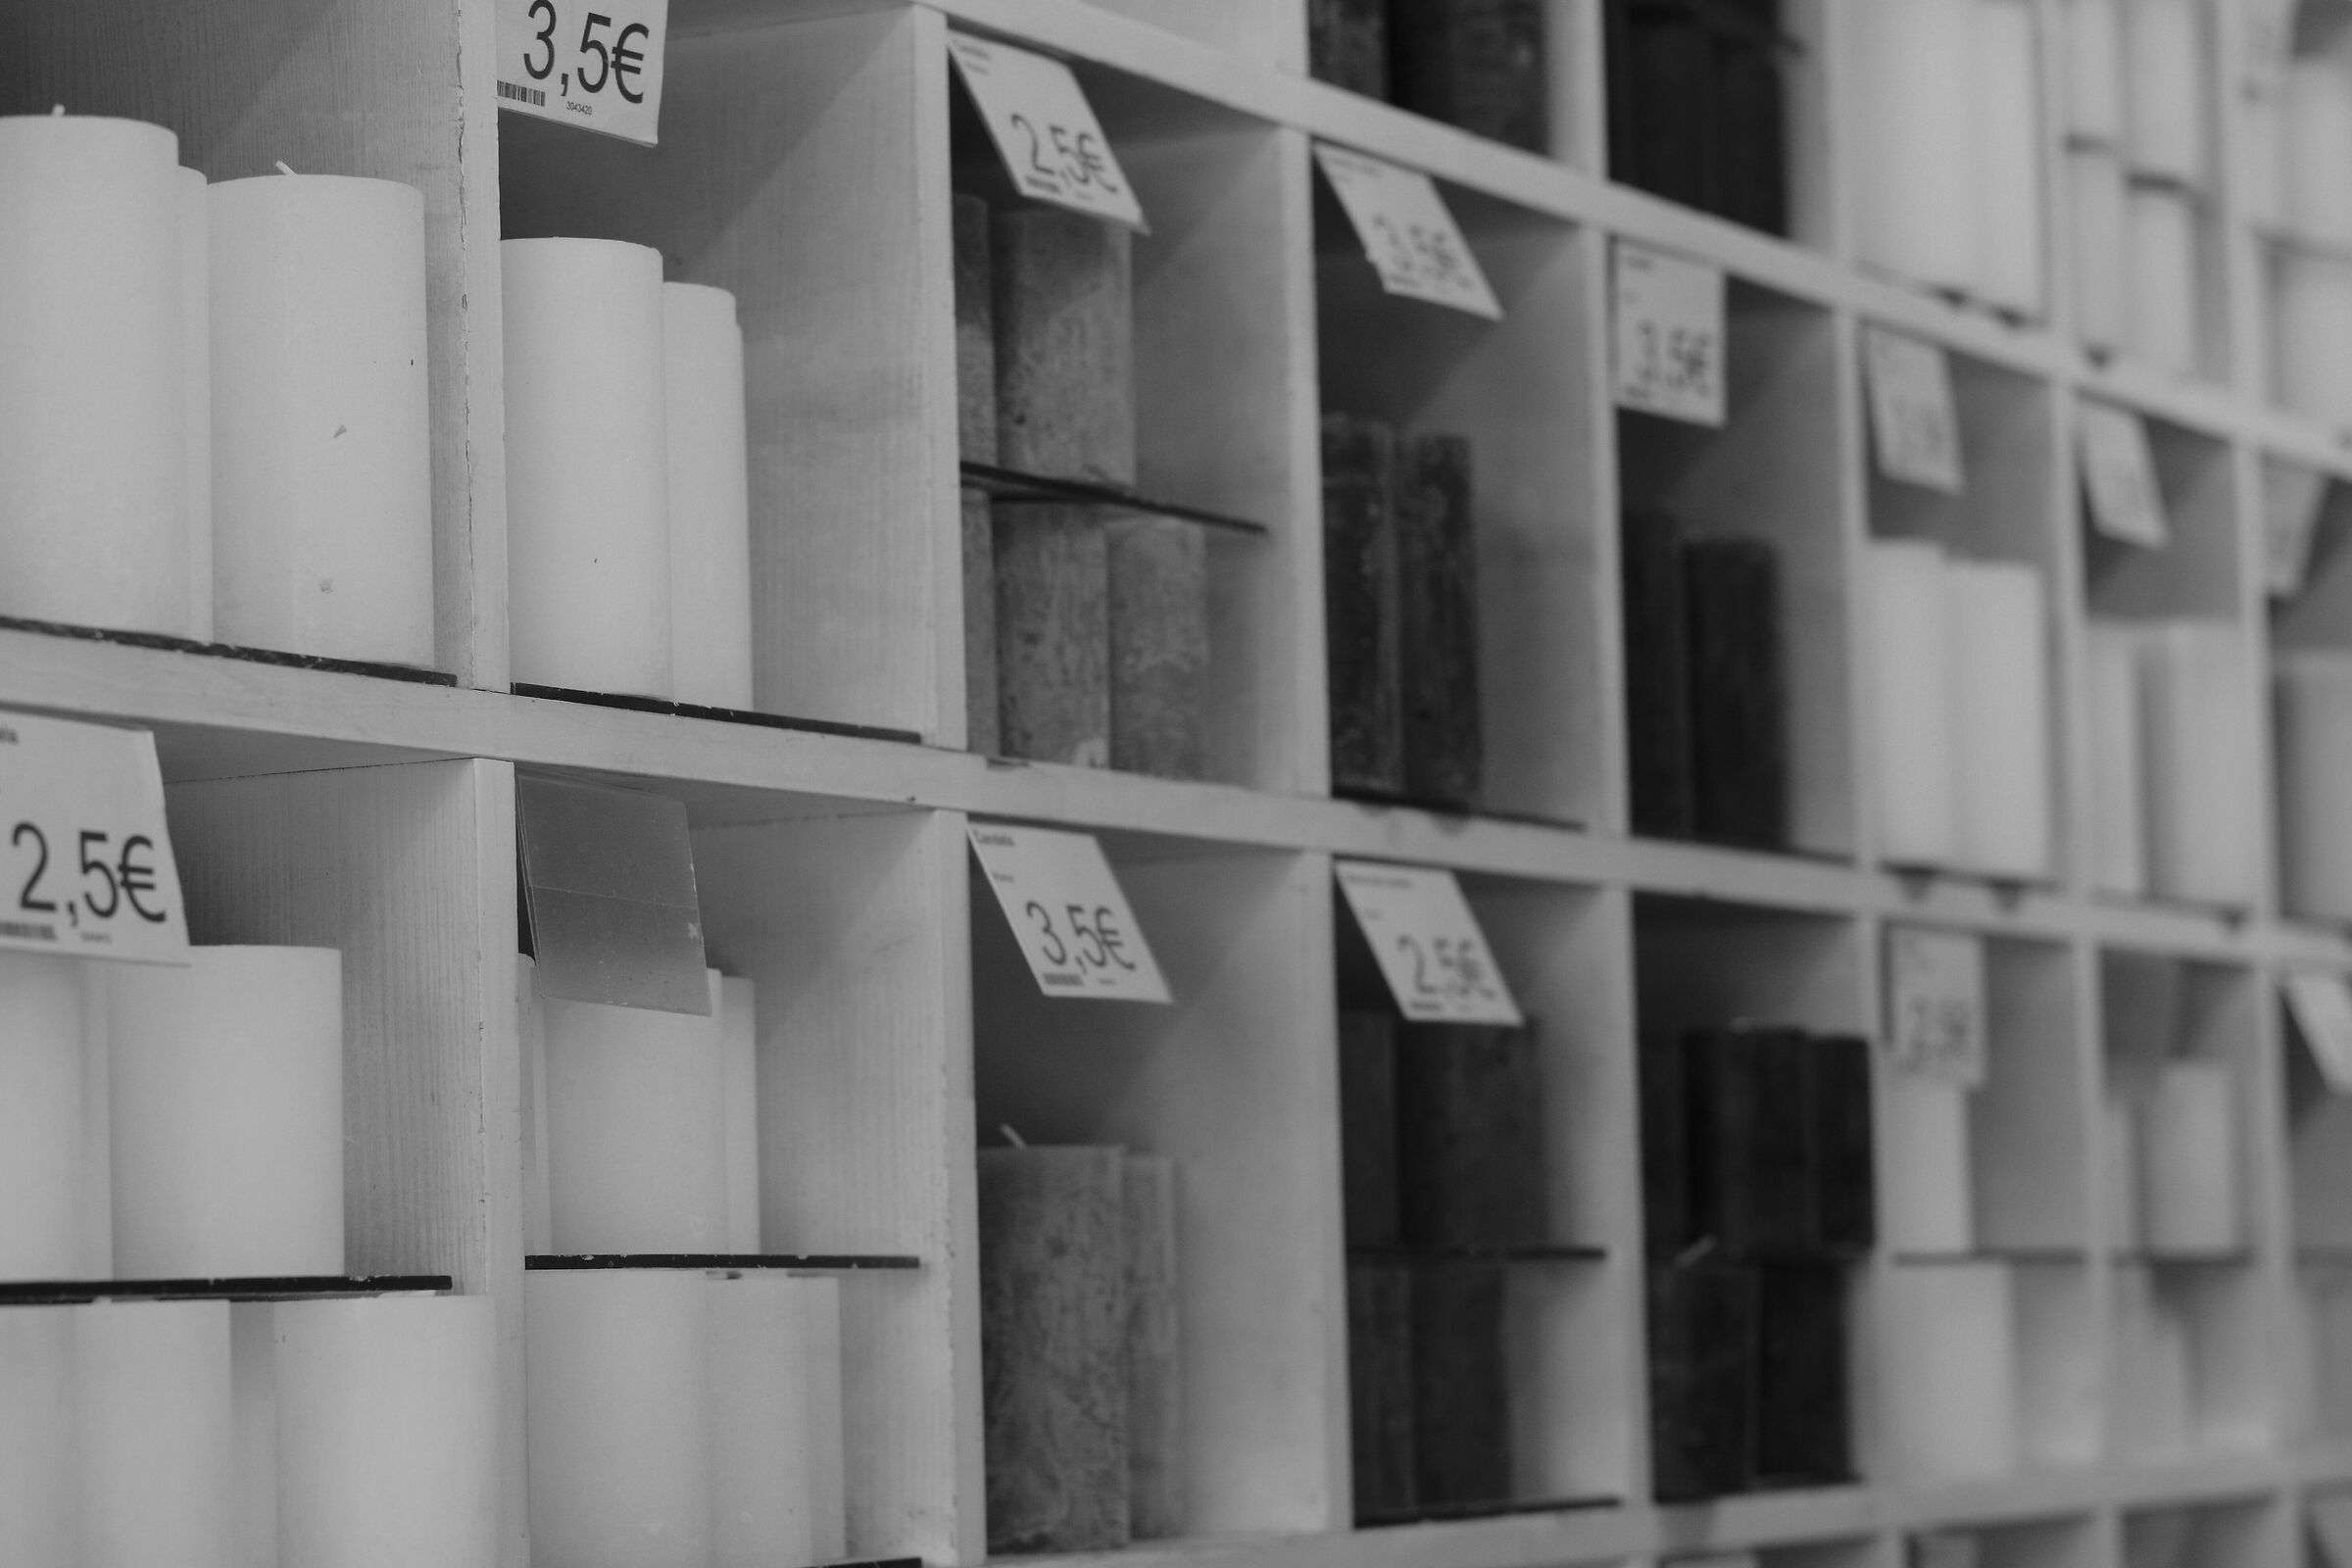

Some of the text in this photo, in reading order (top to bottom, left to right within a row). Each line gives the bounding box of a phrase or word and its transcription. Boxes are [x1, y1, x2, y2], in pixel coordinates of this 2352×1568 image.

[523, 0, 650, 104] 3,5€
[1009, 112, 1120, 195] 2,5€
[12, 820, 167, 929] 2,5€
[1024, 900, 1137, 975] 3,5€
